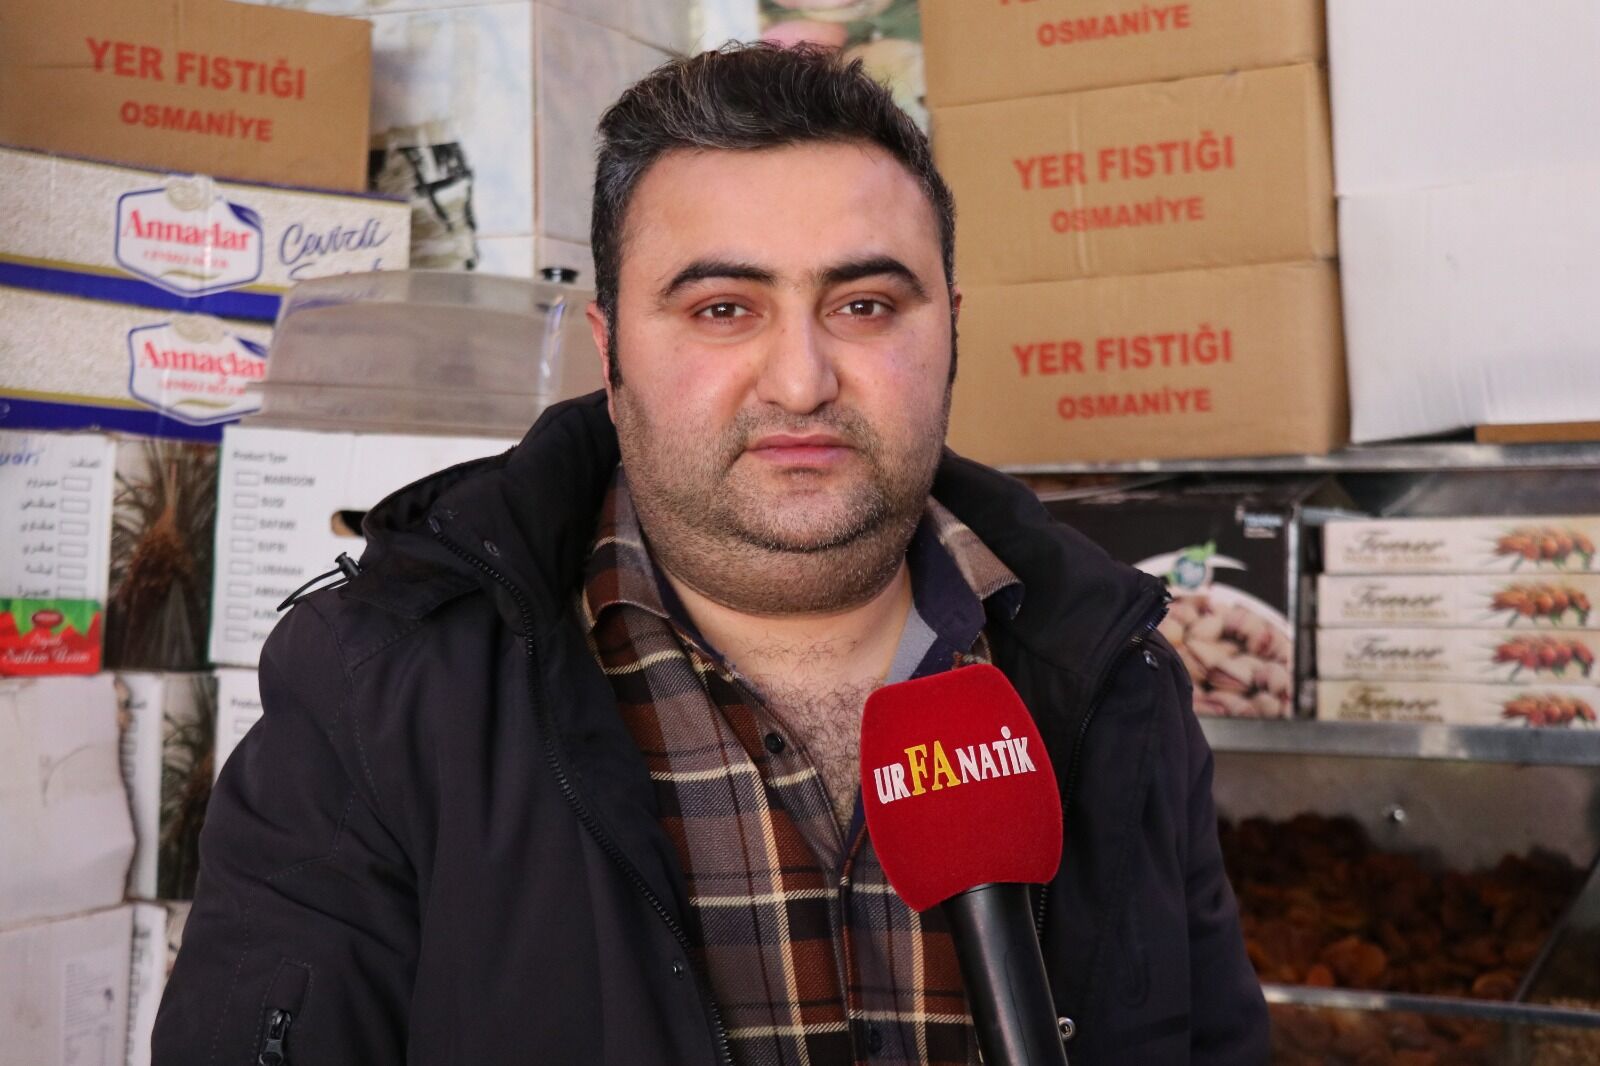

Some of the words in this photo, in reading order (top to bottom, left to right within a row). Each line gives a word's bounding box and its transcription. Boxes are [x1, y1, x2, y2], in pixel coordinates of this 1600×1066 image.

[1036, 4, 1190, 47] OSMANİYE
[86, 38, 164, 82] YER
[176, 50, 306, 100] FISTIĞI
[120, 100, 273, 142] OSMANİYE
[1013, 152, 1087, 190] YER
[1098, 130, 1235, 182] FISTIĞI
[1050, 196, 1204, 234] OSMANİYE
[1012, 340, 1085, 376] YER
[1096, 324, 1233, 372] FISTIĞI
[1057, 388, 1212, 422] OSMANİYE
[873, 725, 1037, 804] URFANATİK
